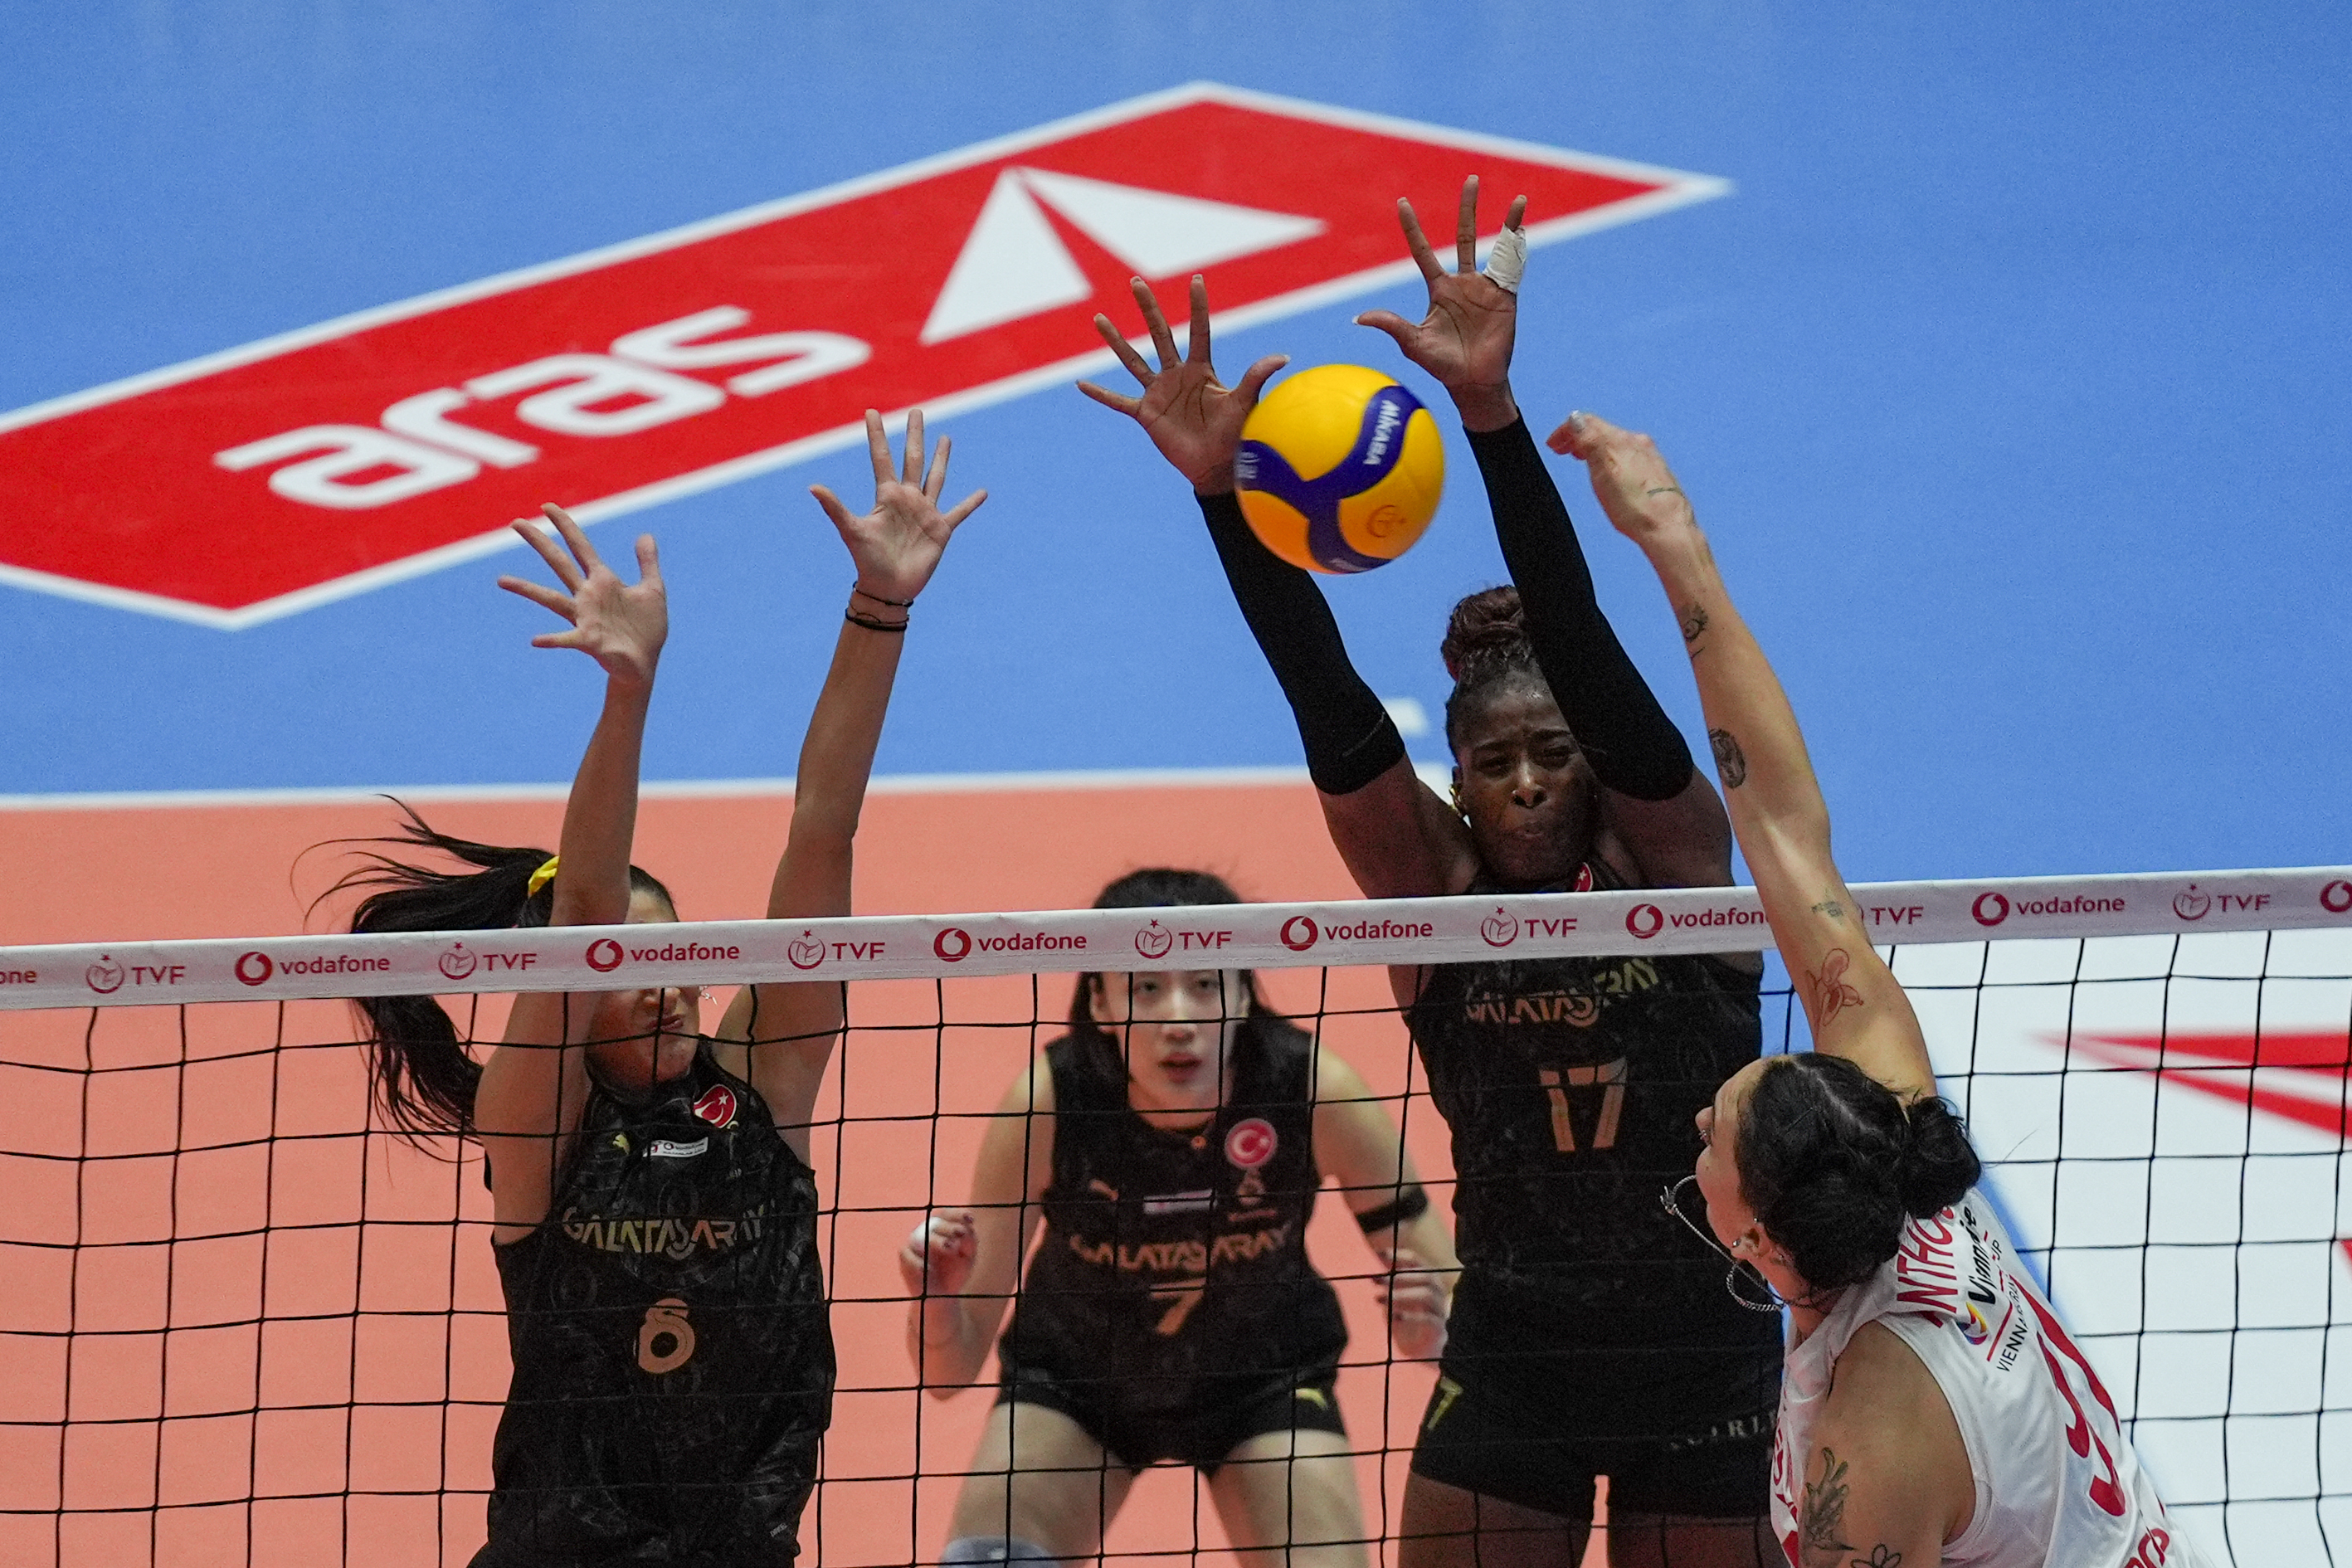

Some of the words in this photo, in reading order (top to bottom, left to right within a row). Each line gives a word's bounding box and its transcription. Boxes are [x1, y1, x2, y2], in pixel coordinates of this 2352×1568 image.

[212, 303, 873, 509] aras
[130, 965, 187, 986] TVF
[279, 953, 391, 976] vodafone
[483, 952, 538, 971] TVF
[631, 942, 740, 962] vodafone
[832, 942, 885, 961] TVF
[978, 932, 1088, 952] vodafone
[1178, 931, 1232, 950] TVF
[1324, 919, 1433, 940] vodafone
[1525, 918, 1578, 938] TVF
[1669, 908, 1769, 928] vodafon
[1871, 906, 1924, 925] TVF
[2016, 894, 2126, 915] vodafone
[2217, 894, 2271, 913] TVF
[1539, 1056, 1628, 1152] 17
[637, 1298, 696, 1375] 6
[1149, 1276, 1207, 1335] 7
